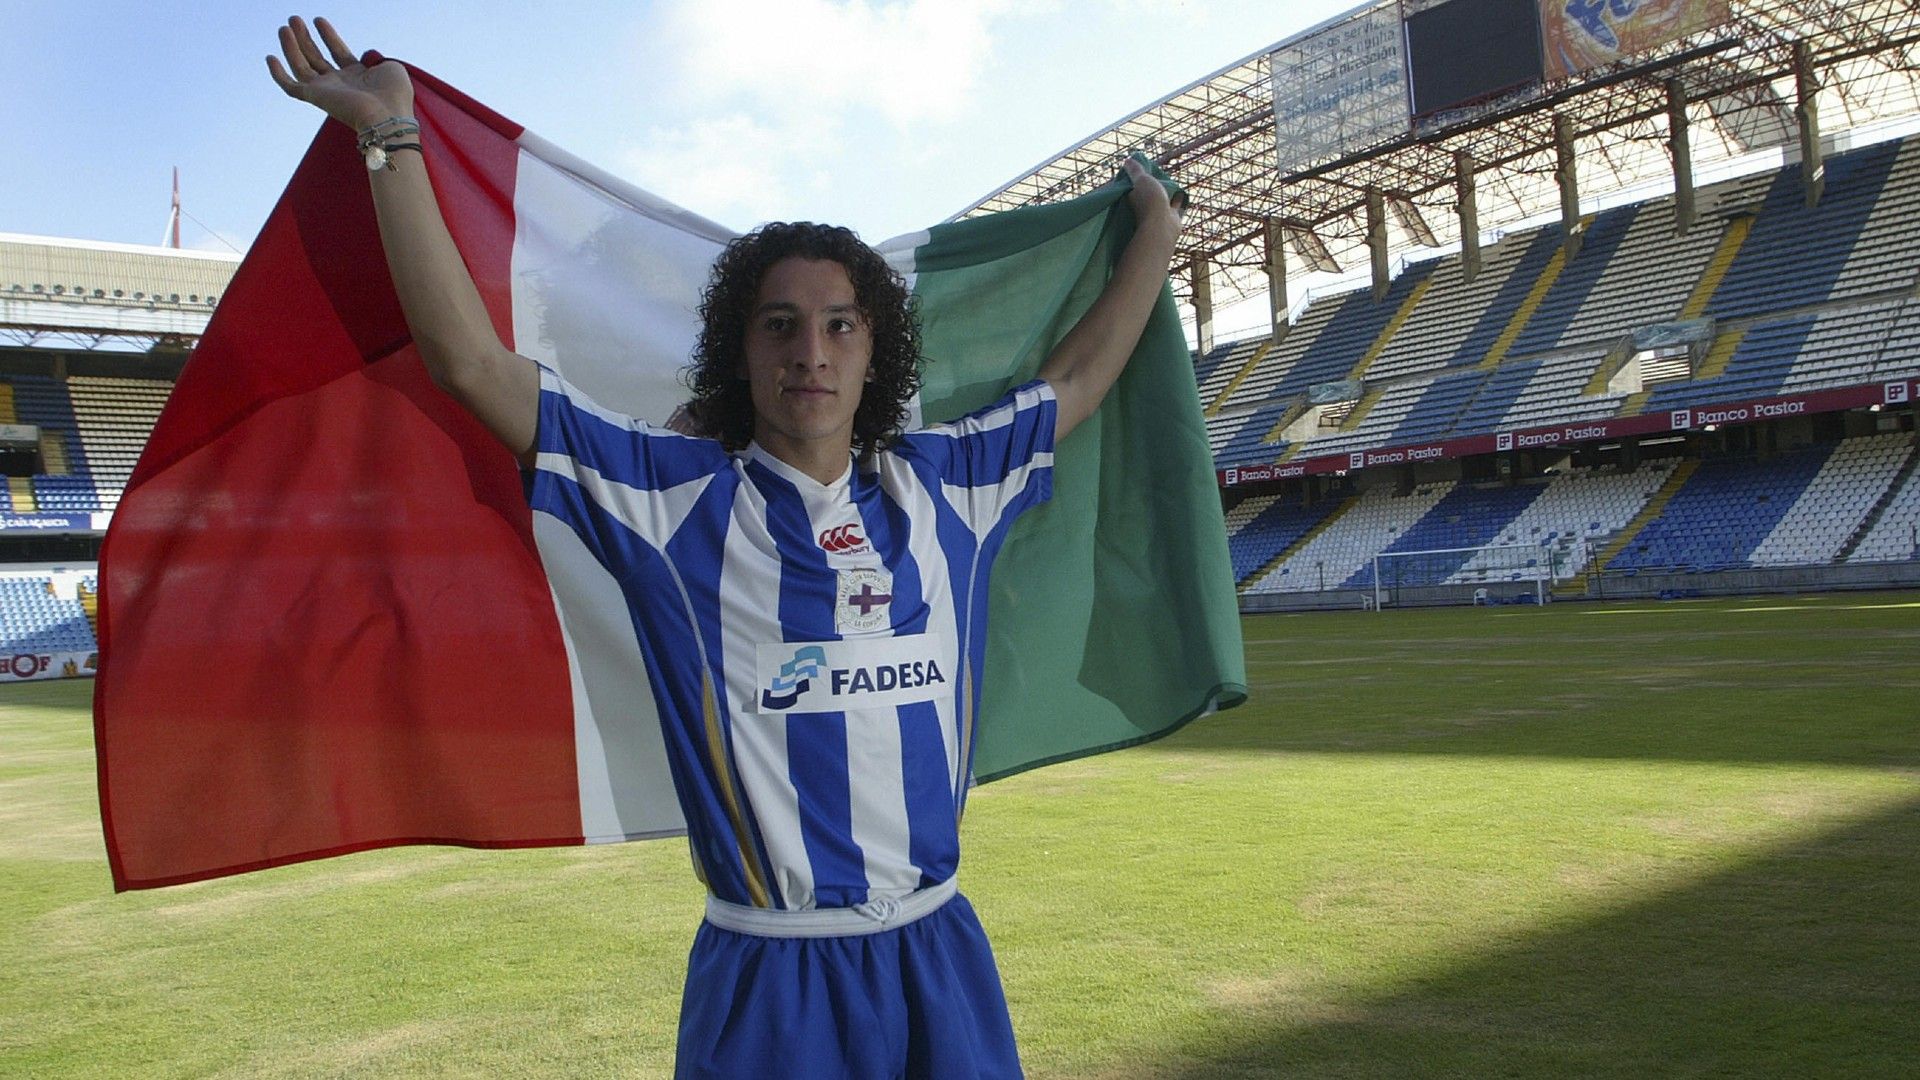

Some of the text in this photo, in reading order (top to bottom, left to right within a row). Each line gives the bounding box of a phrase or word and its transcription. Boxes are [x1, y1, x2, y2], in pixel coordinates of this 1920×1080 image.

[1697, 401, 1806, 424] Banco Pastor
[1518, 426, 1607, 446] Banco Pastor
[1367, 442, 1443, 465] Banco Pastor
[1241, 466, 1304, 481] Banco Pastor
[831, 660, 945, 695] FADESA
